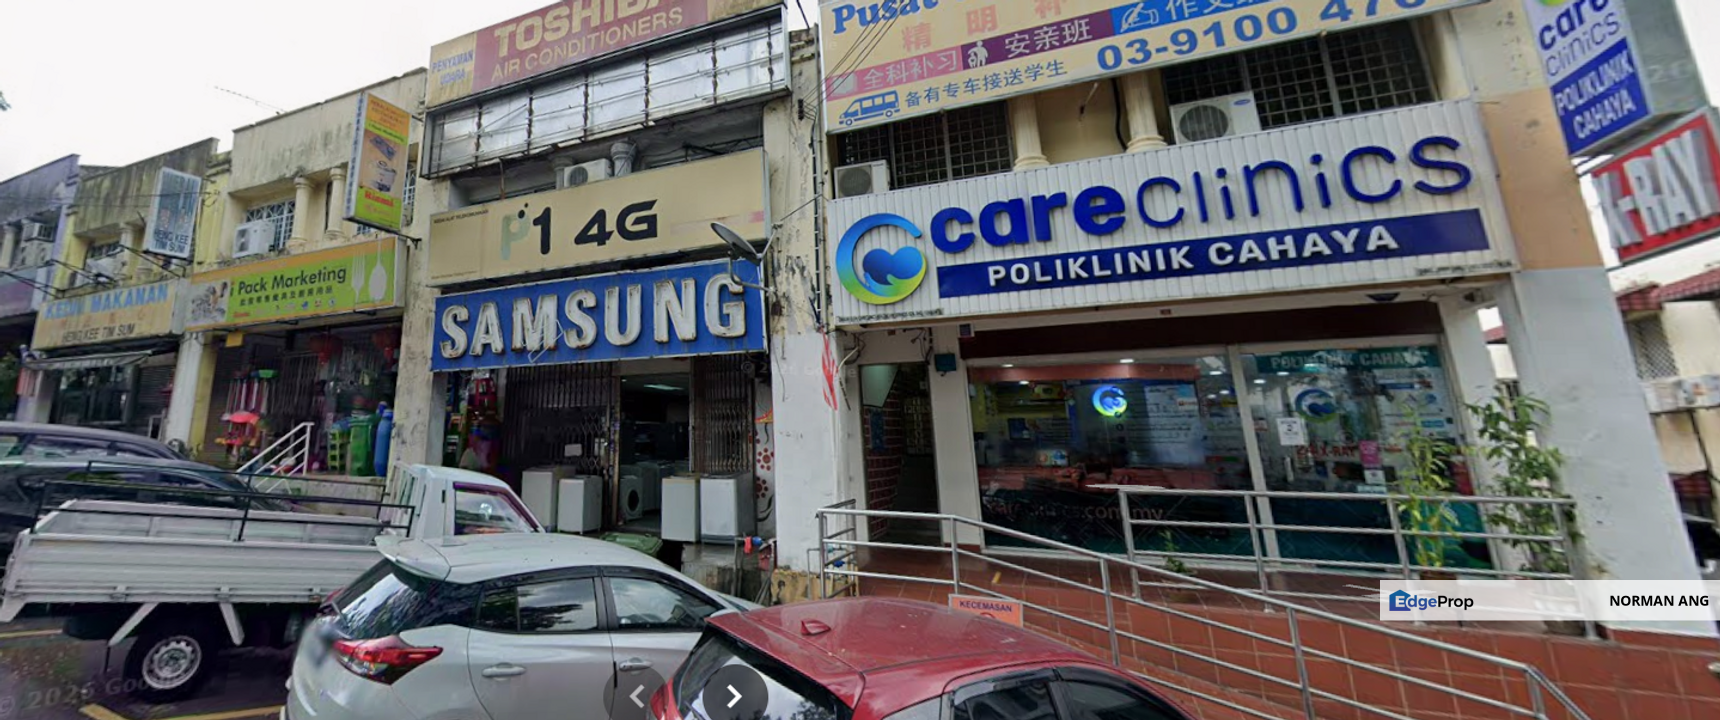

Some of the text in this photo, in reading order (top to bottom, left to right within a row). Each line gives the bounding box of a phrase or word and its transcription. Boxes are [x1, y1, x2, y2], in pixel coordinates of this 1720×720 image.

[491, 7, 683, 82] AIR CONDITIONERS
[494, 0, 660, 58] TOSHIB
[1004, 18, 1093, 58] 安亲班
[1097, 7, 1299, 71] 03-9100
[432, 50, 474, 73] PENYAMAN
[863, 50, 958, 90] 全科补习
[905, 60, 1068, 108] 备有专车接送学生
[1555, 50, 1634, 115] POLIKLINIK
[1573, 88, 1637, 138] CAHAYA
[1592, 129, 1720, 249] X-RAY
[574, 199, 658, 246] 4G
[238, 277, 267, 295] Pack
[272, 266, 347, 290] Marketing
[988, 225, 1398, 288] POLIKLINIK CAHAYA
[90, 283, 169, 313] MAKANAN
[440, 273, 746, 359] SAMSUNG
[82, 327, 99, 341] KEE
[959, 600, 1013, 613] KECEMASAN
